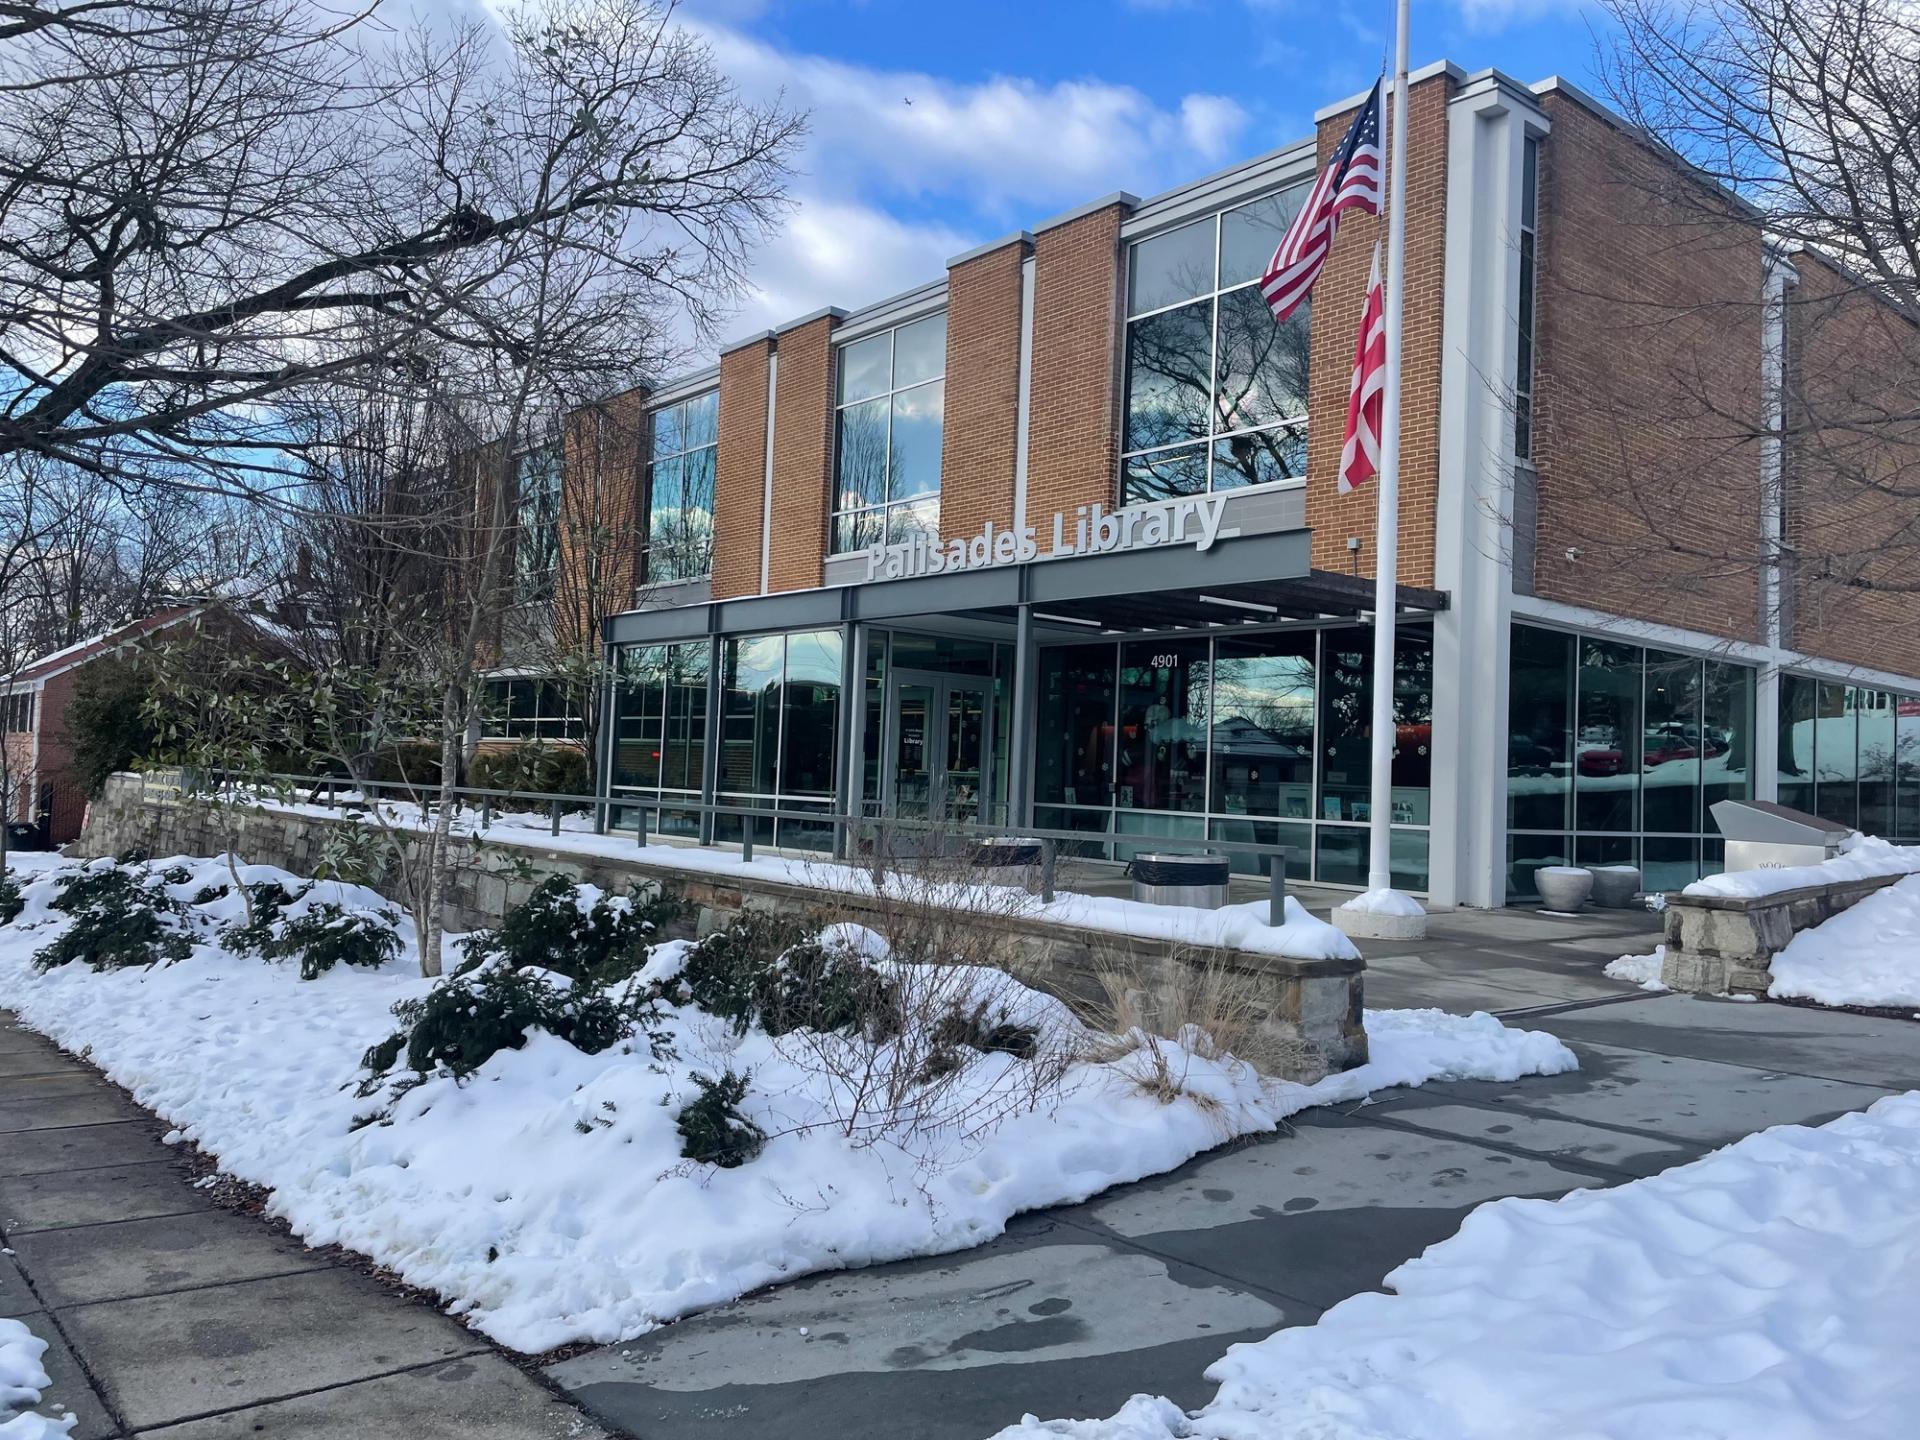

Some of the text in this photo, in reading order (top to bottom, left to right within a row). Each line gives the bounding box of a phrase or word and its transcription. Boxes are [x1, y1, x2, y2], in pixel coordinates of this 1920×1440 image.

[867, 496, 1228, 581] Palisades Library
[1150, 653, 1178, 668] 4901
